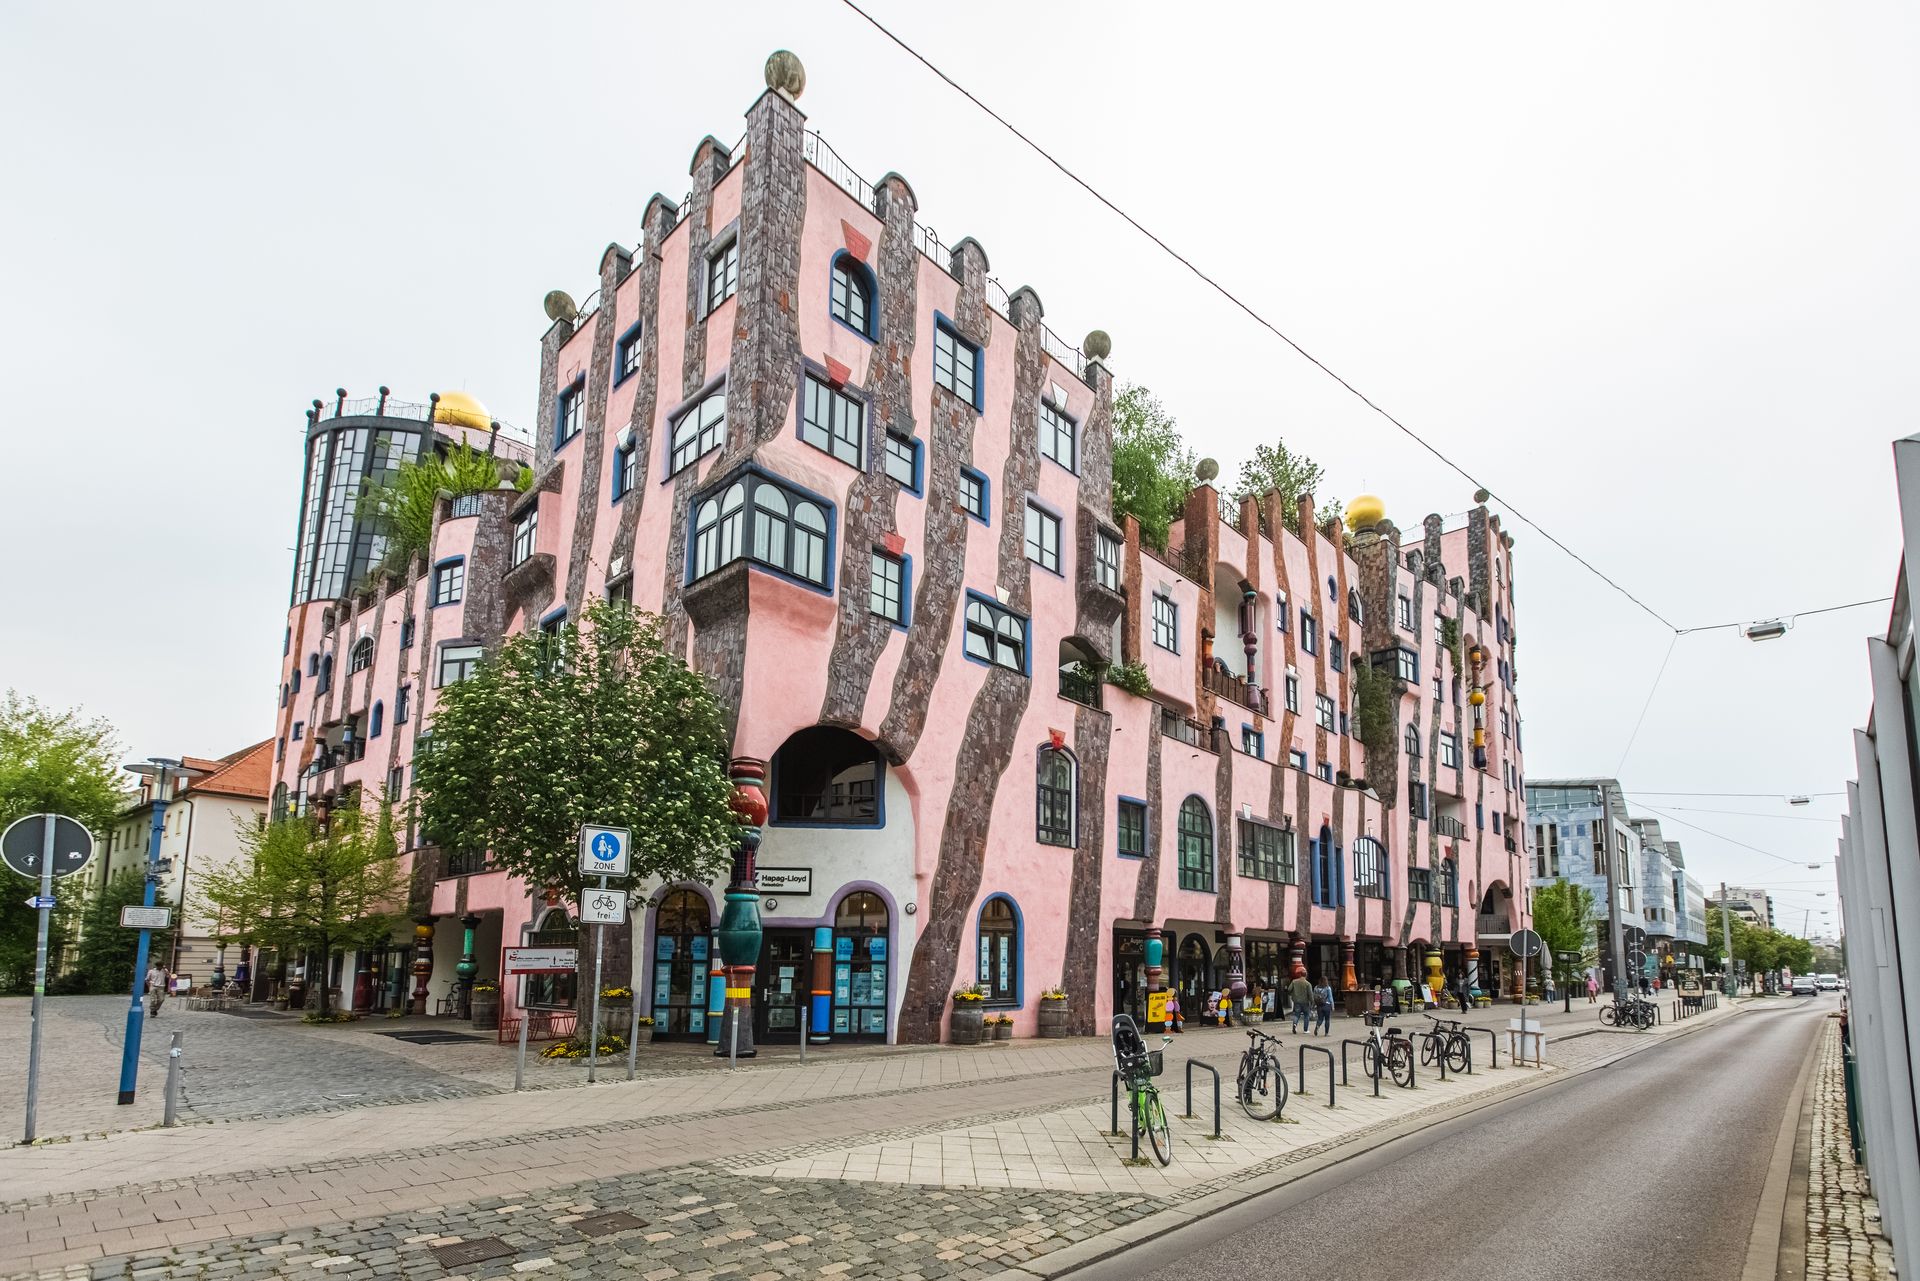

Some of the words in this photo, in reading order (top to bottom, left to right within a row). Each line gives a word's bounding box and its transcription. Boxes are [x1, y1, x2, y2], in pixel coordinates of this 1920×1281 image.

[593, 861, 616, 871] ZONE
[761, 874, 806, 883] Hapag-Lloyd
[597, 911, 611, 920] frei
